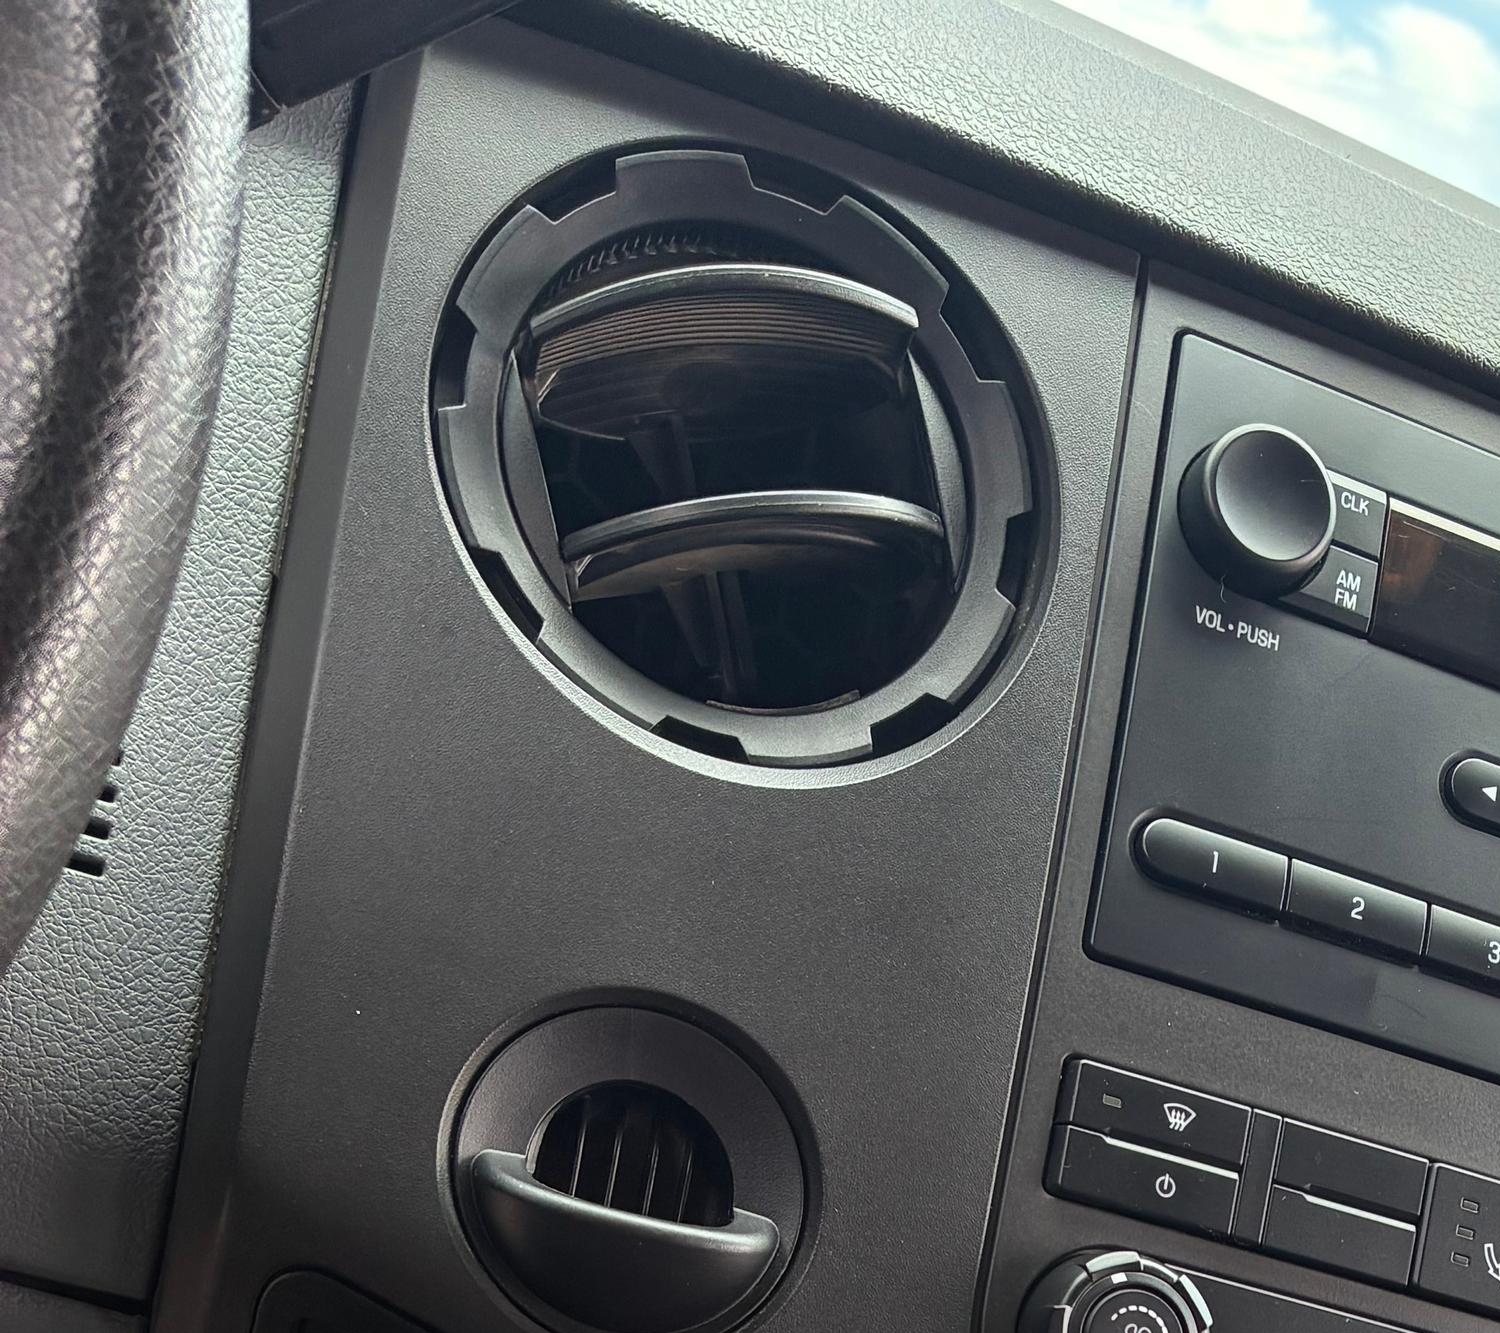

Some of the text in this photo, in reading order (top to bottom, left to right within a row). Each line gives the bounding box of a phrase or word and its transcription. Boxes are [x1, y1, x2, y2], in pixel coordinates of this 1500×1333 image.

[1340, 491, 1370, 516] CLK
[1336, 570, 1361, 592] AM
[1334, 588, 1358, 611] FM
[1195, 604, 1280, 651] VOL PUSH
[1211, 850, 1220, 874] 1
[1350, 896, 1366, 920] 2
